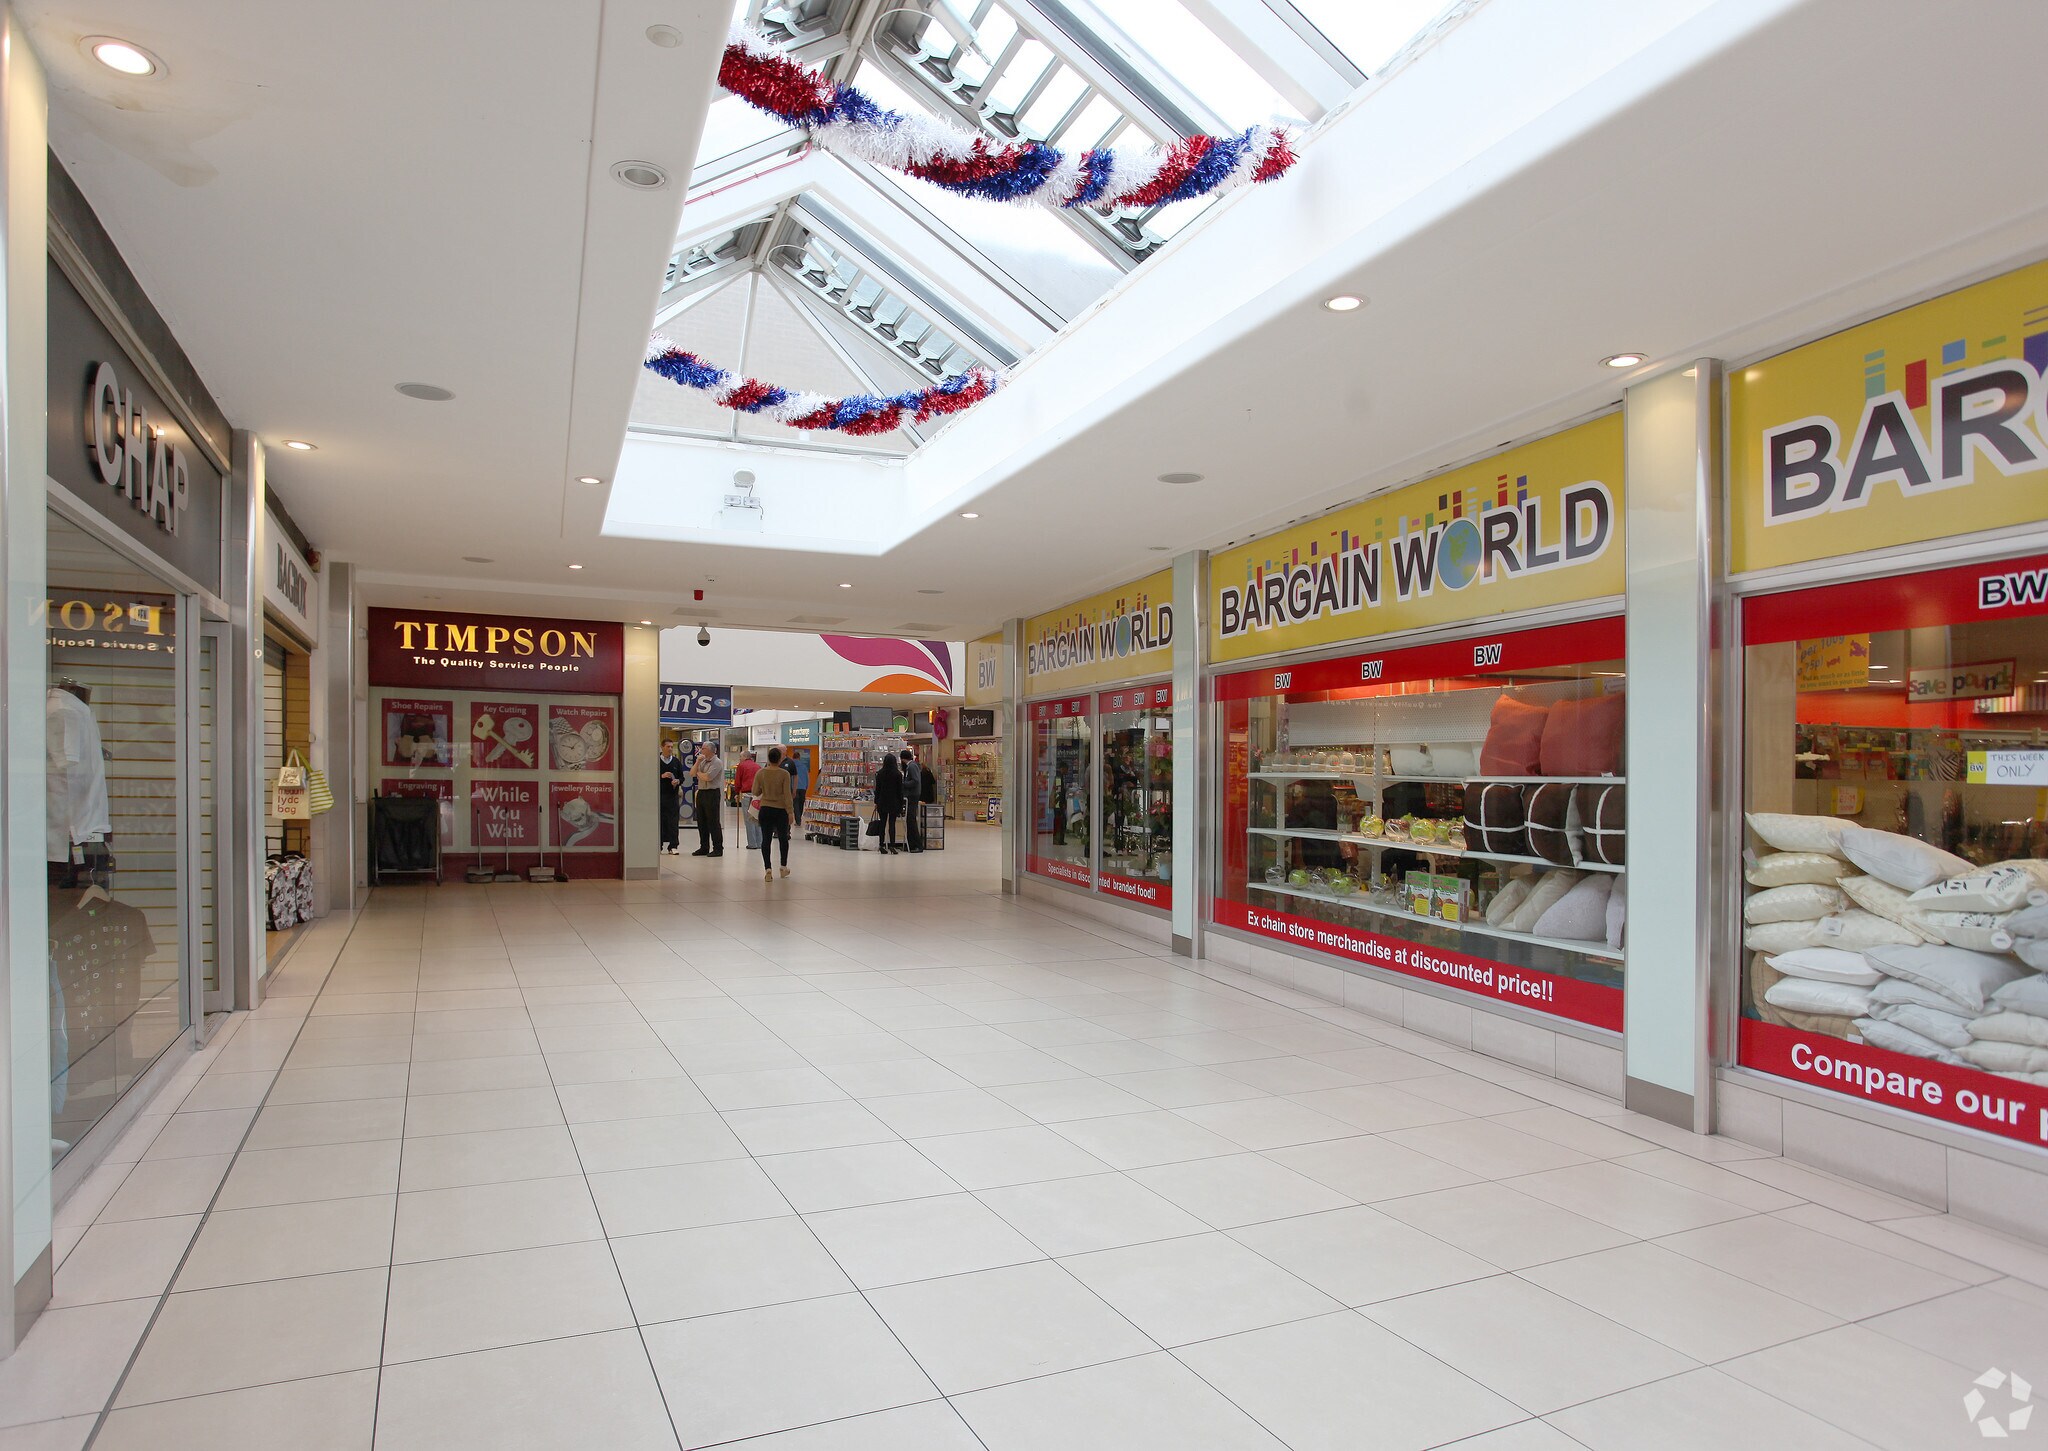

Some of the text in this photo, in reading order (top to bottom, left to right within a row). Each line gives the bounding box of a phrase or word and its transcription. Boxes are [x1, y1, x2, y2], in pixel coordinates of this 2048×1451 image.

[93, 361, 189, 538] CHAP
[1766, 362, 2048, 521] BAR
[1221, 486, 1609, 636] BARGAIN WORLD
[394, 621, 598, 658] TIMPSON
[1027, 626, 1095, 675] BARGAIN
[1474, 644, 1502, 666] BW
[413, 656, 579, 672] The Quality Service People
[1362, 660, 1383, 680] BW
[979, 660, 996, 690] BW
[1275, 673, 1291, 690] BW
[1156, 689, 1168, 703] BW
[392, 701, 443, 712] Shoe Repairs
[483, 704, 527, 716] Key Cutting
[556, 707, 608, 718] Watch Repairs
[1991, 753, 2045, 762] THIS WEEK
[1997, 764, 2035, 778] ONLY
[398, 782, 438, 792] Engraving
[480, 786, 530, 803] While
[551, 785, 612, 794] Jewellery Repairs
[277, 805, 297, 816] bag
[489, 806, 521, 821] You
[486, 823, 525, 839] Wait
[1047, 863, 1072, 878] Specialists
[1112, 880, 1136, 896] branded
[1137, 885, 1157, 901] food!!
[1247, 910, 1554, 1002] Ex chain store merchandise at discounted price!!
[1790, 1043, 1944, 1105] Compare
[1955, 1090, 2026, 1125] our
